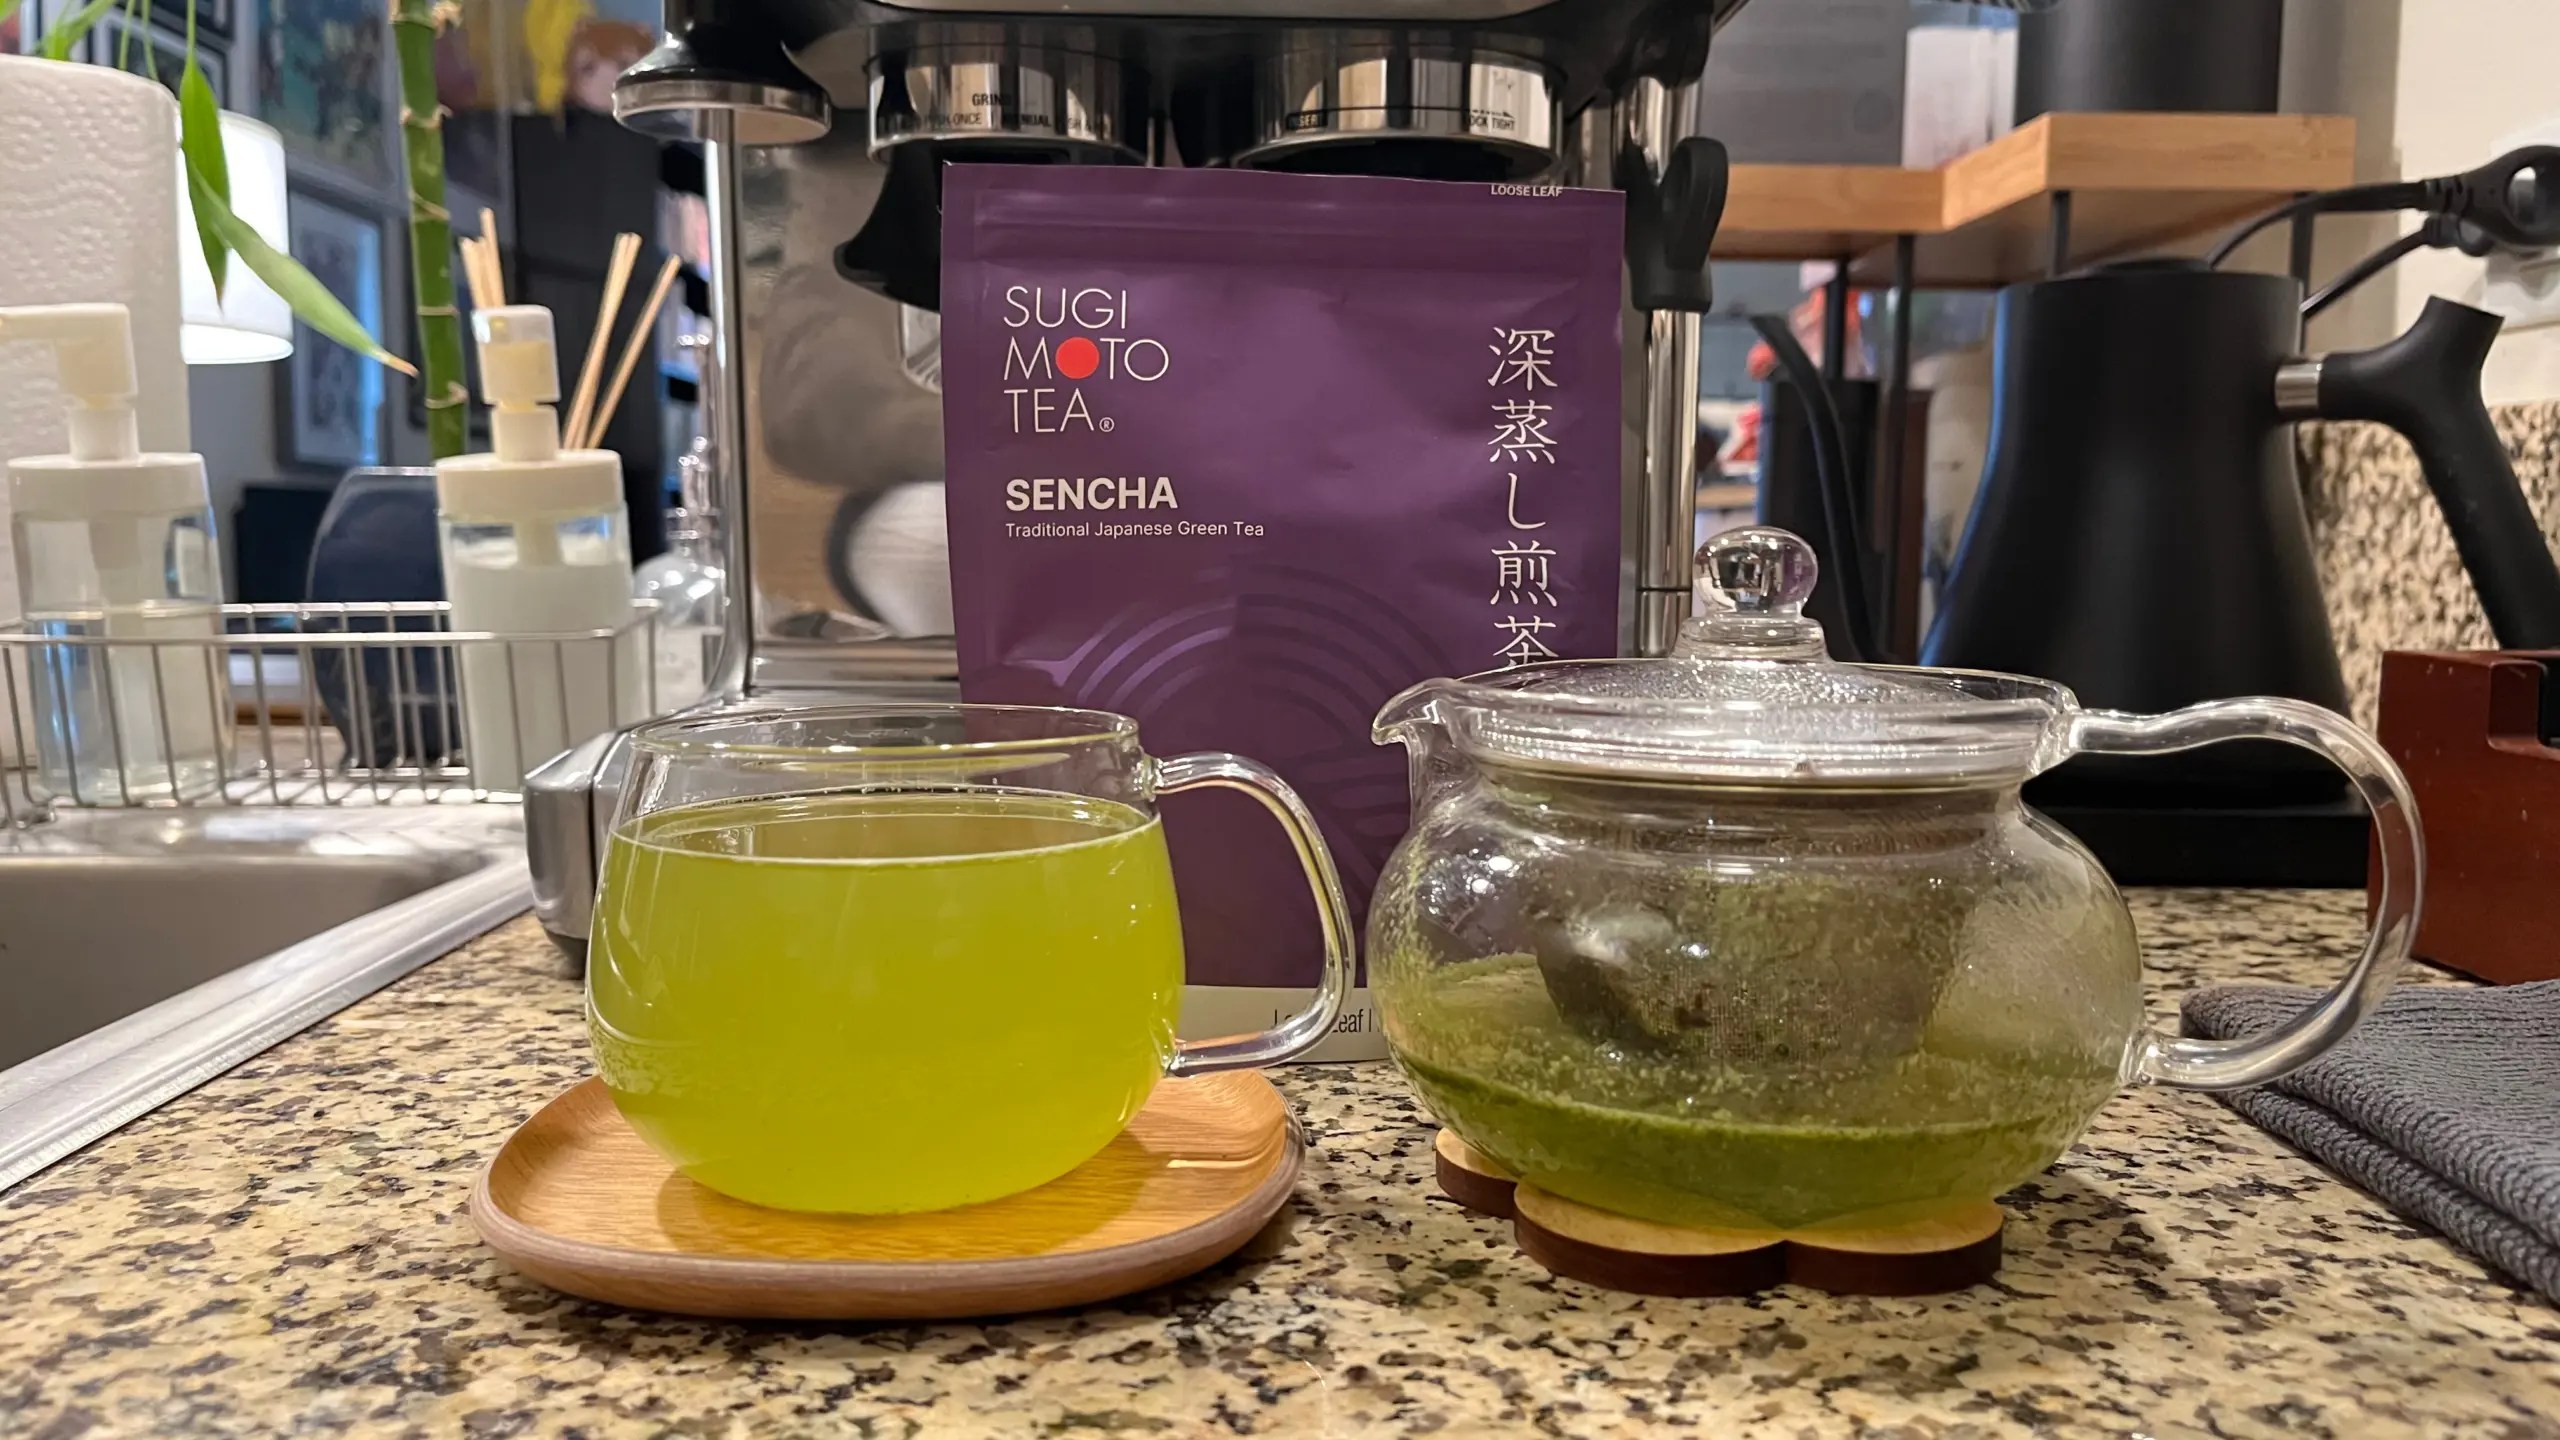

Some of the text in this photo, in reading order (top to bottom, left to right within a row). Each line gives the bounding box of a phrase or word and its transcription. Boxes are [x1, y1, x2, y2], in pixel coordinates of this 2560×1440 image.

[1491, 184, 1563, 198] LOOSE LEAF
[1003, 285, 1127, 330] SUGI
[1005, 476, 1179, 512] SENCHA
[1487, 326, 1560, 671] 深蒸し煎茶
[1005, 520, 1265, 540] Traditional Japanese Green Tea
[1332, 1008, 1364, 1033] eaf
